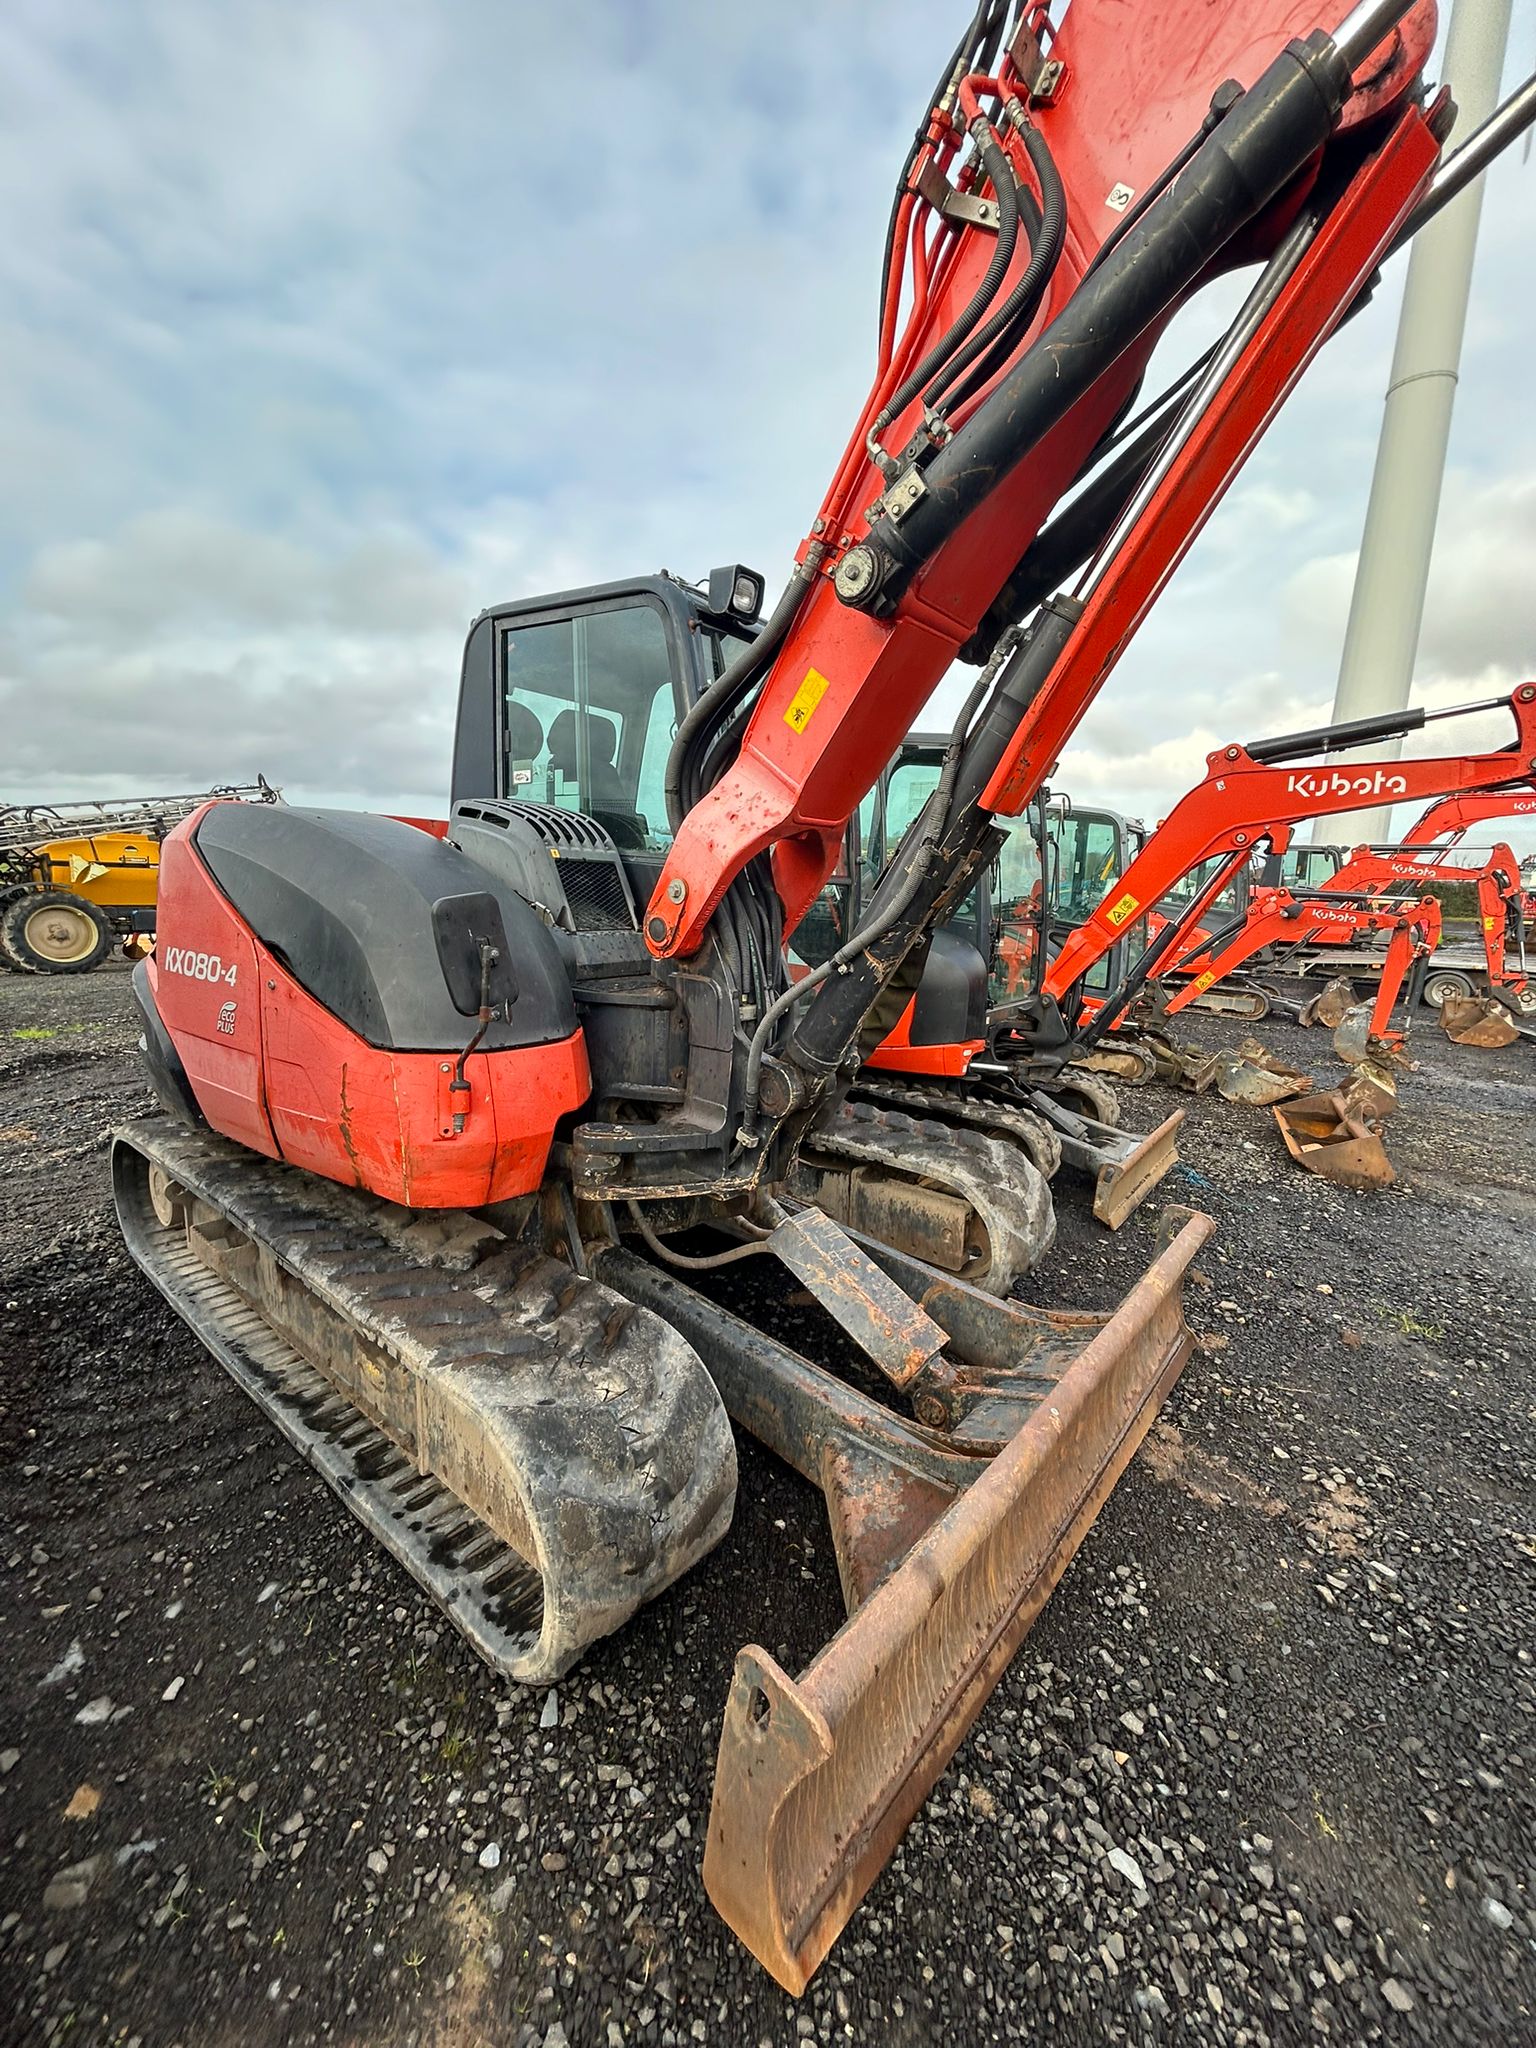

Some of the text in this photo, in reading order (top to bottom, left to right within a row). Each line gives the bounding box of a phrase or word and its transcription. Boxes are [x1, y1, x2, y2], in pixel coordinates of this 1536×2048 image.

[1287, 770, 1407, 798] Kubota
[1391, 863, 1437, 877] Kubota
[1312, 908, 1357, 923] Kubota
[164, 946, 238, 987] KX080-4
[221, 1010, 235, 1023] eco
[216, 1020, 235, 1035] PLUS
